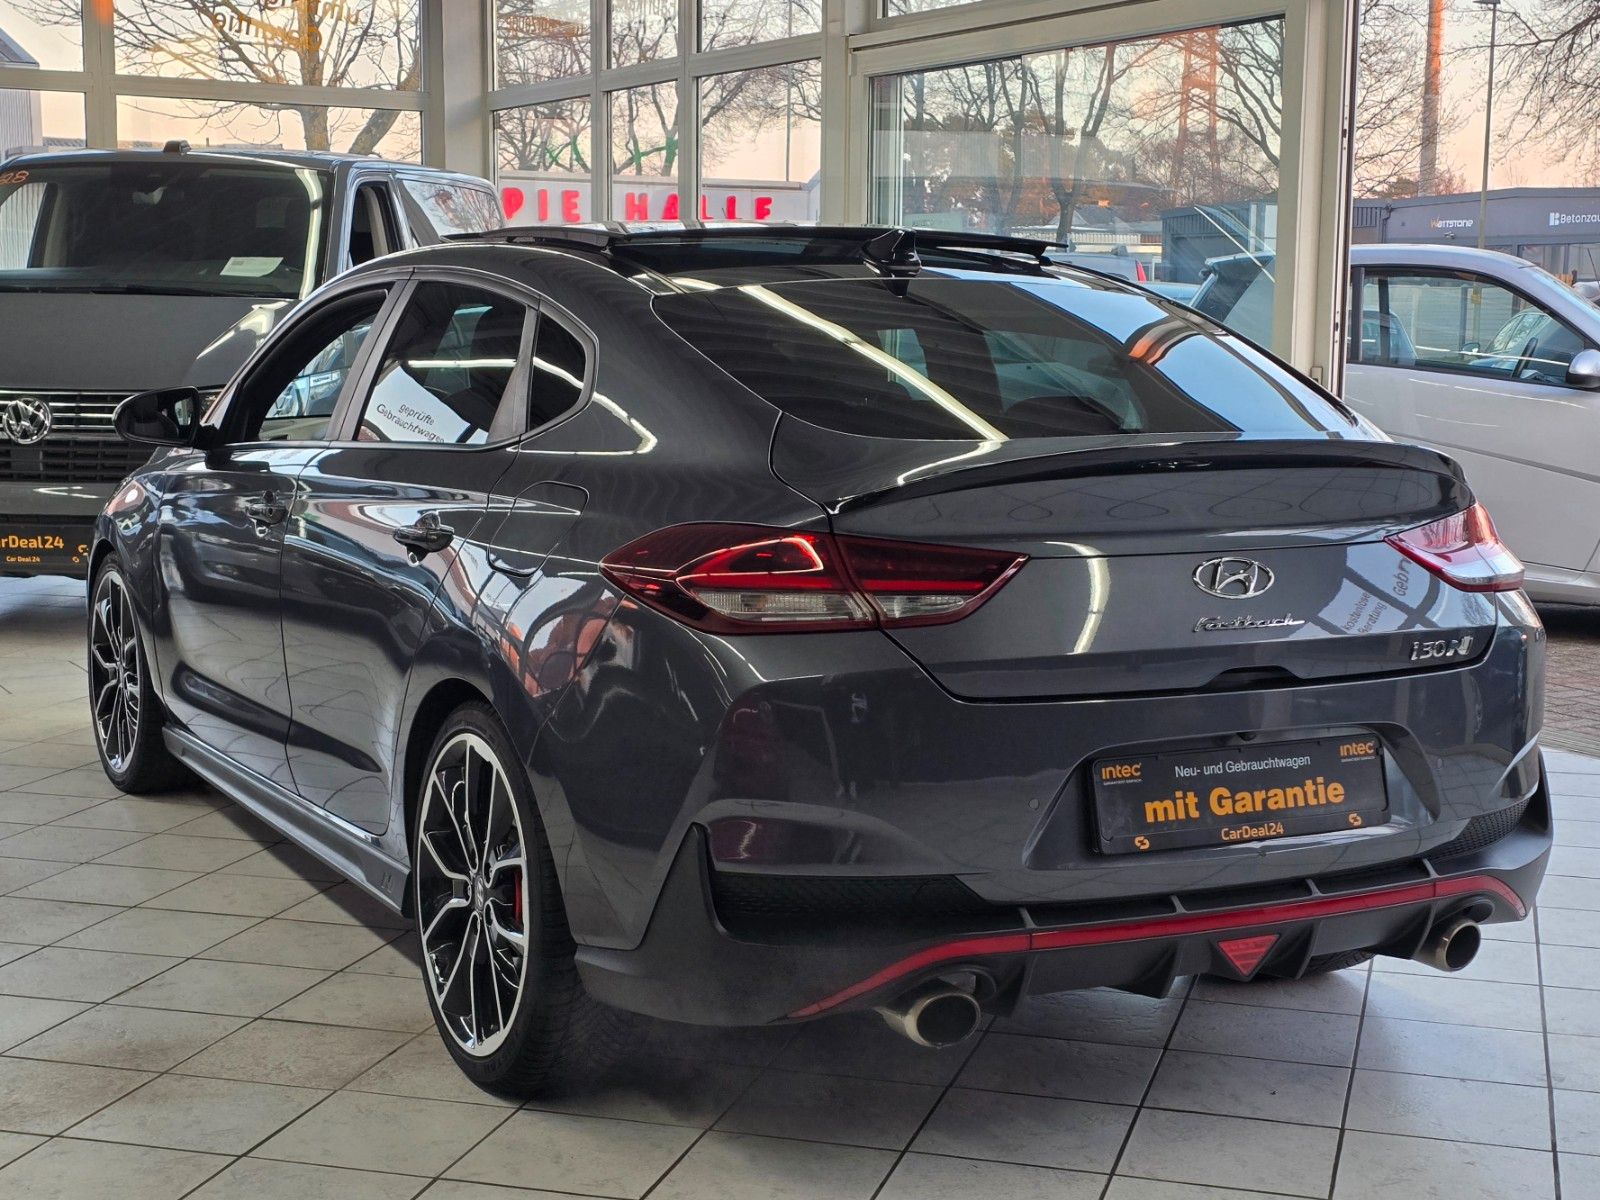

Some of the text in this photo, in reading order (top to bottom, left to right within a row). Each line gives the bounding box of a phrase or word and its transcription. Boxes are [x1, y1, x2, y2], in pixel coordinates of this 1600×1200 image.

[398, 403, 435, 426] geprüfte
[0, 535, 65, 549] rDeal24
[1174, 754, 1311, 778] Neu- und Gebrauchtwagen
[1144, 776, 1345, 823] mit Garantie
[1221, 822, 1285, 841] CarDeal24
